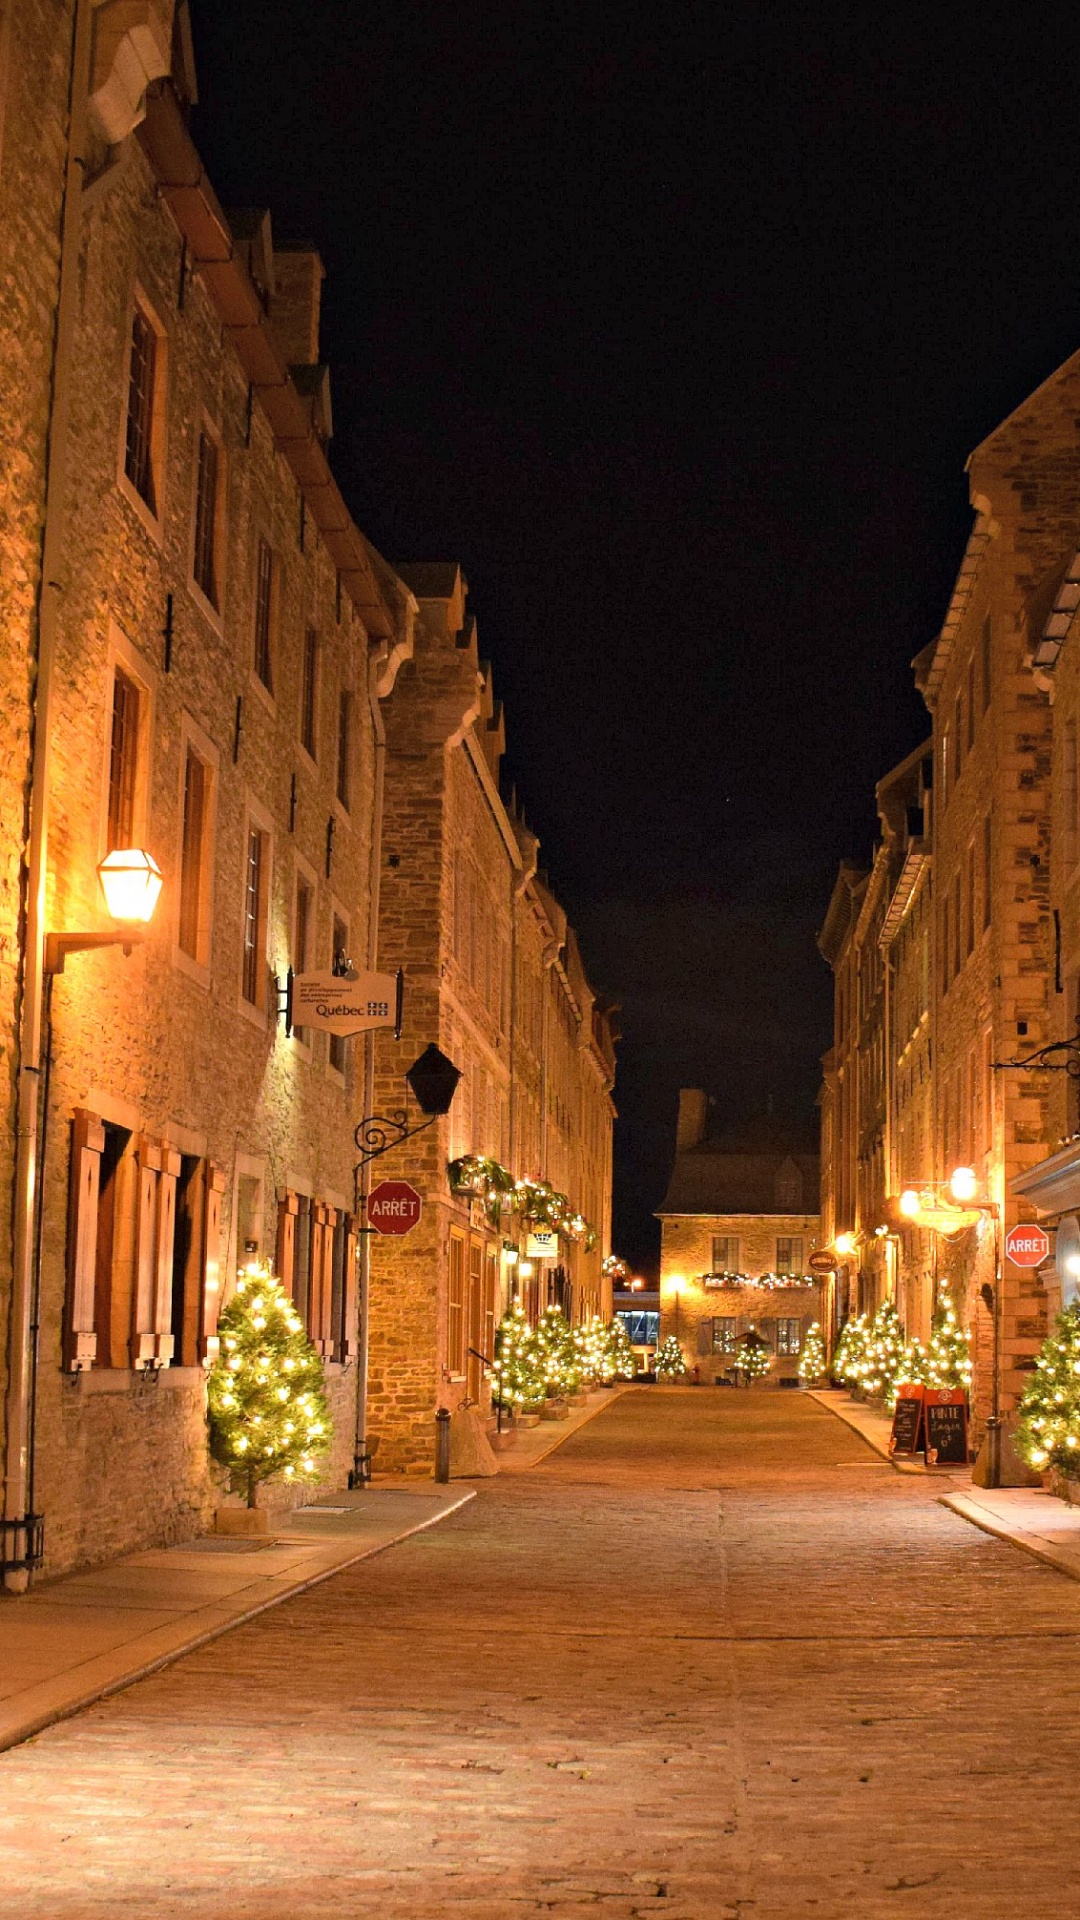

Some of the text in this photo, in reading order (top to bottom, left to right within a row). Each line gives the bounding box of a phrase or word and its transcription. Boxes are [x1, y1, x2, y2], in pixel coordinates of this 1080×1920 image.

[316, 1004, 365, 1018] Québec
[371, 1197, 417, 1216] ARRÊT
[1008, 1237, 1047, 1253] ARRÊT
